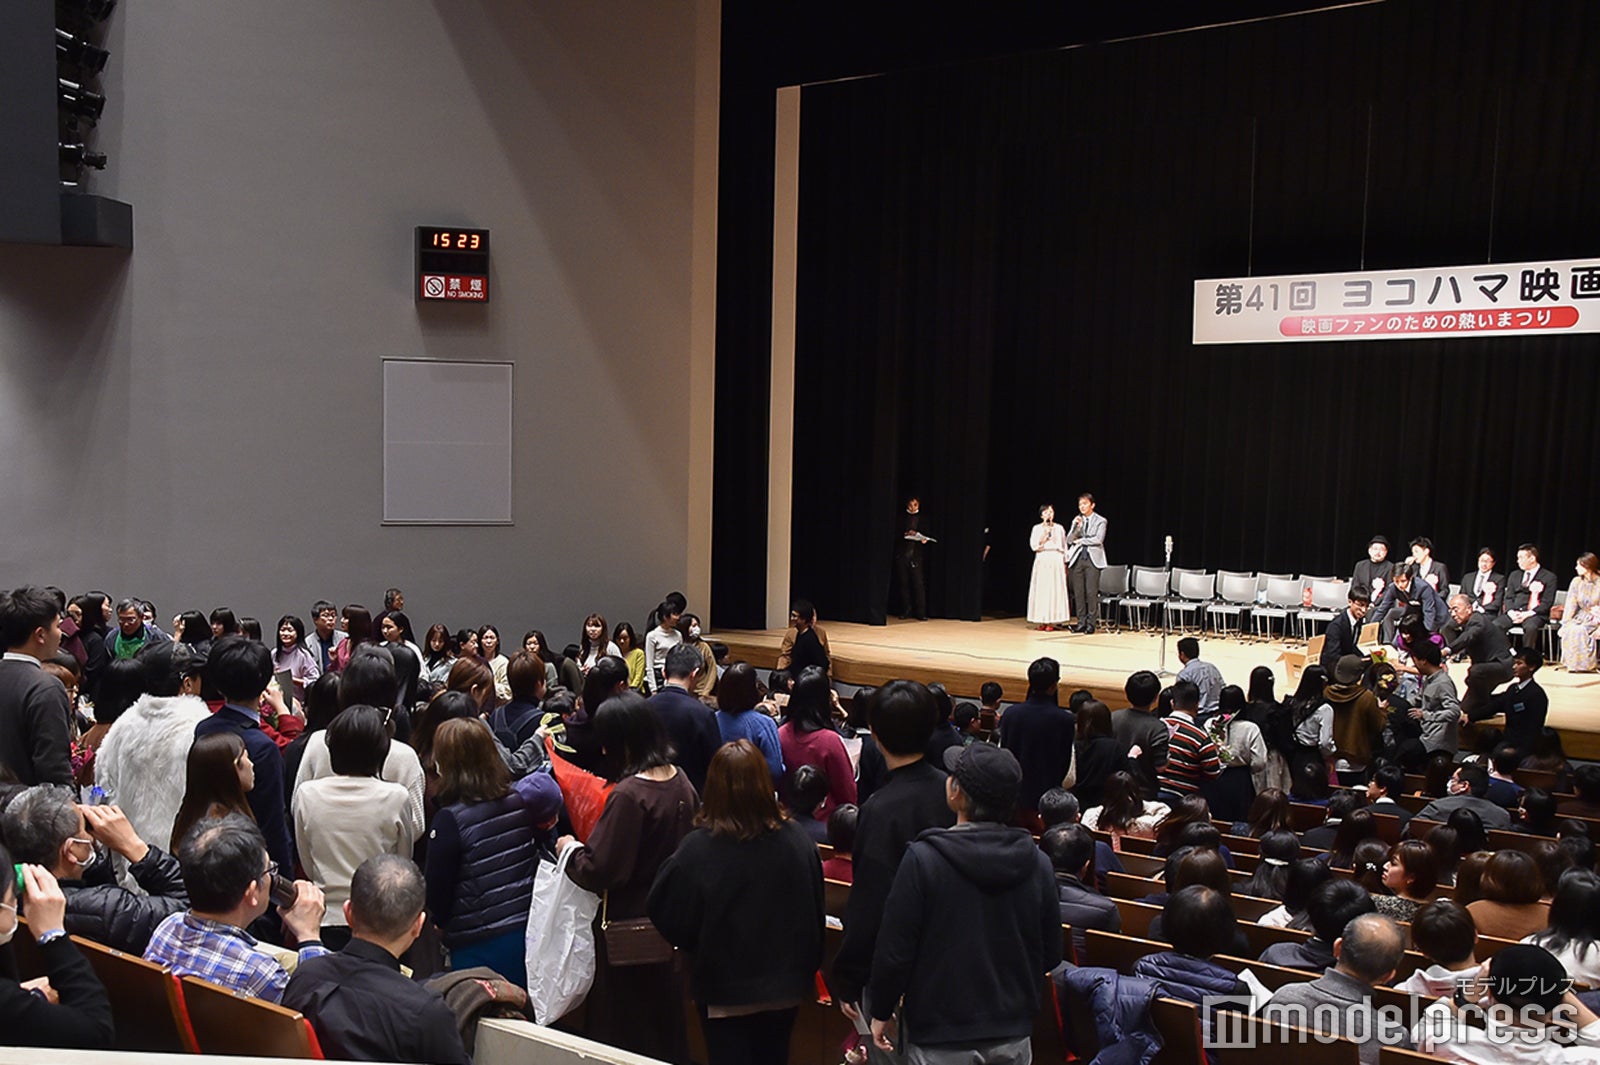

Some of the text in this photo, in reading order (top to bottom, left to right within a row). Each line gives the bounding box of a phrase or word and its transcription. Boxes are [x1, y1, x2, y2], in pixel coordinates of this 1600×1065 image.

[433, 233, 480, 249] 15 23
[457, 291, 484, 299] SMOKING
[1215, 267, 1600, 315] 第41回 ヨコハマ映画
[1301, 309, 1551, 333] 映画ファンのための熱いまつり
